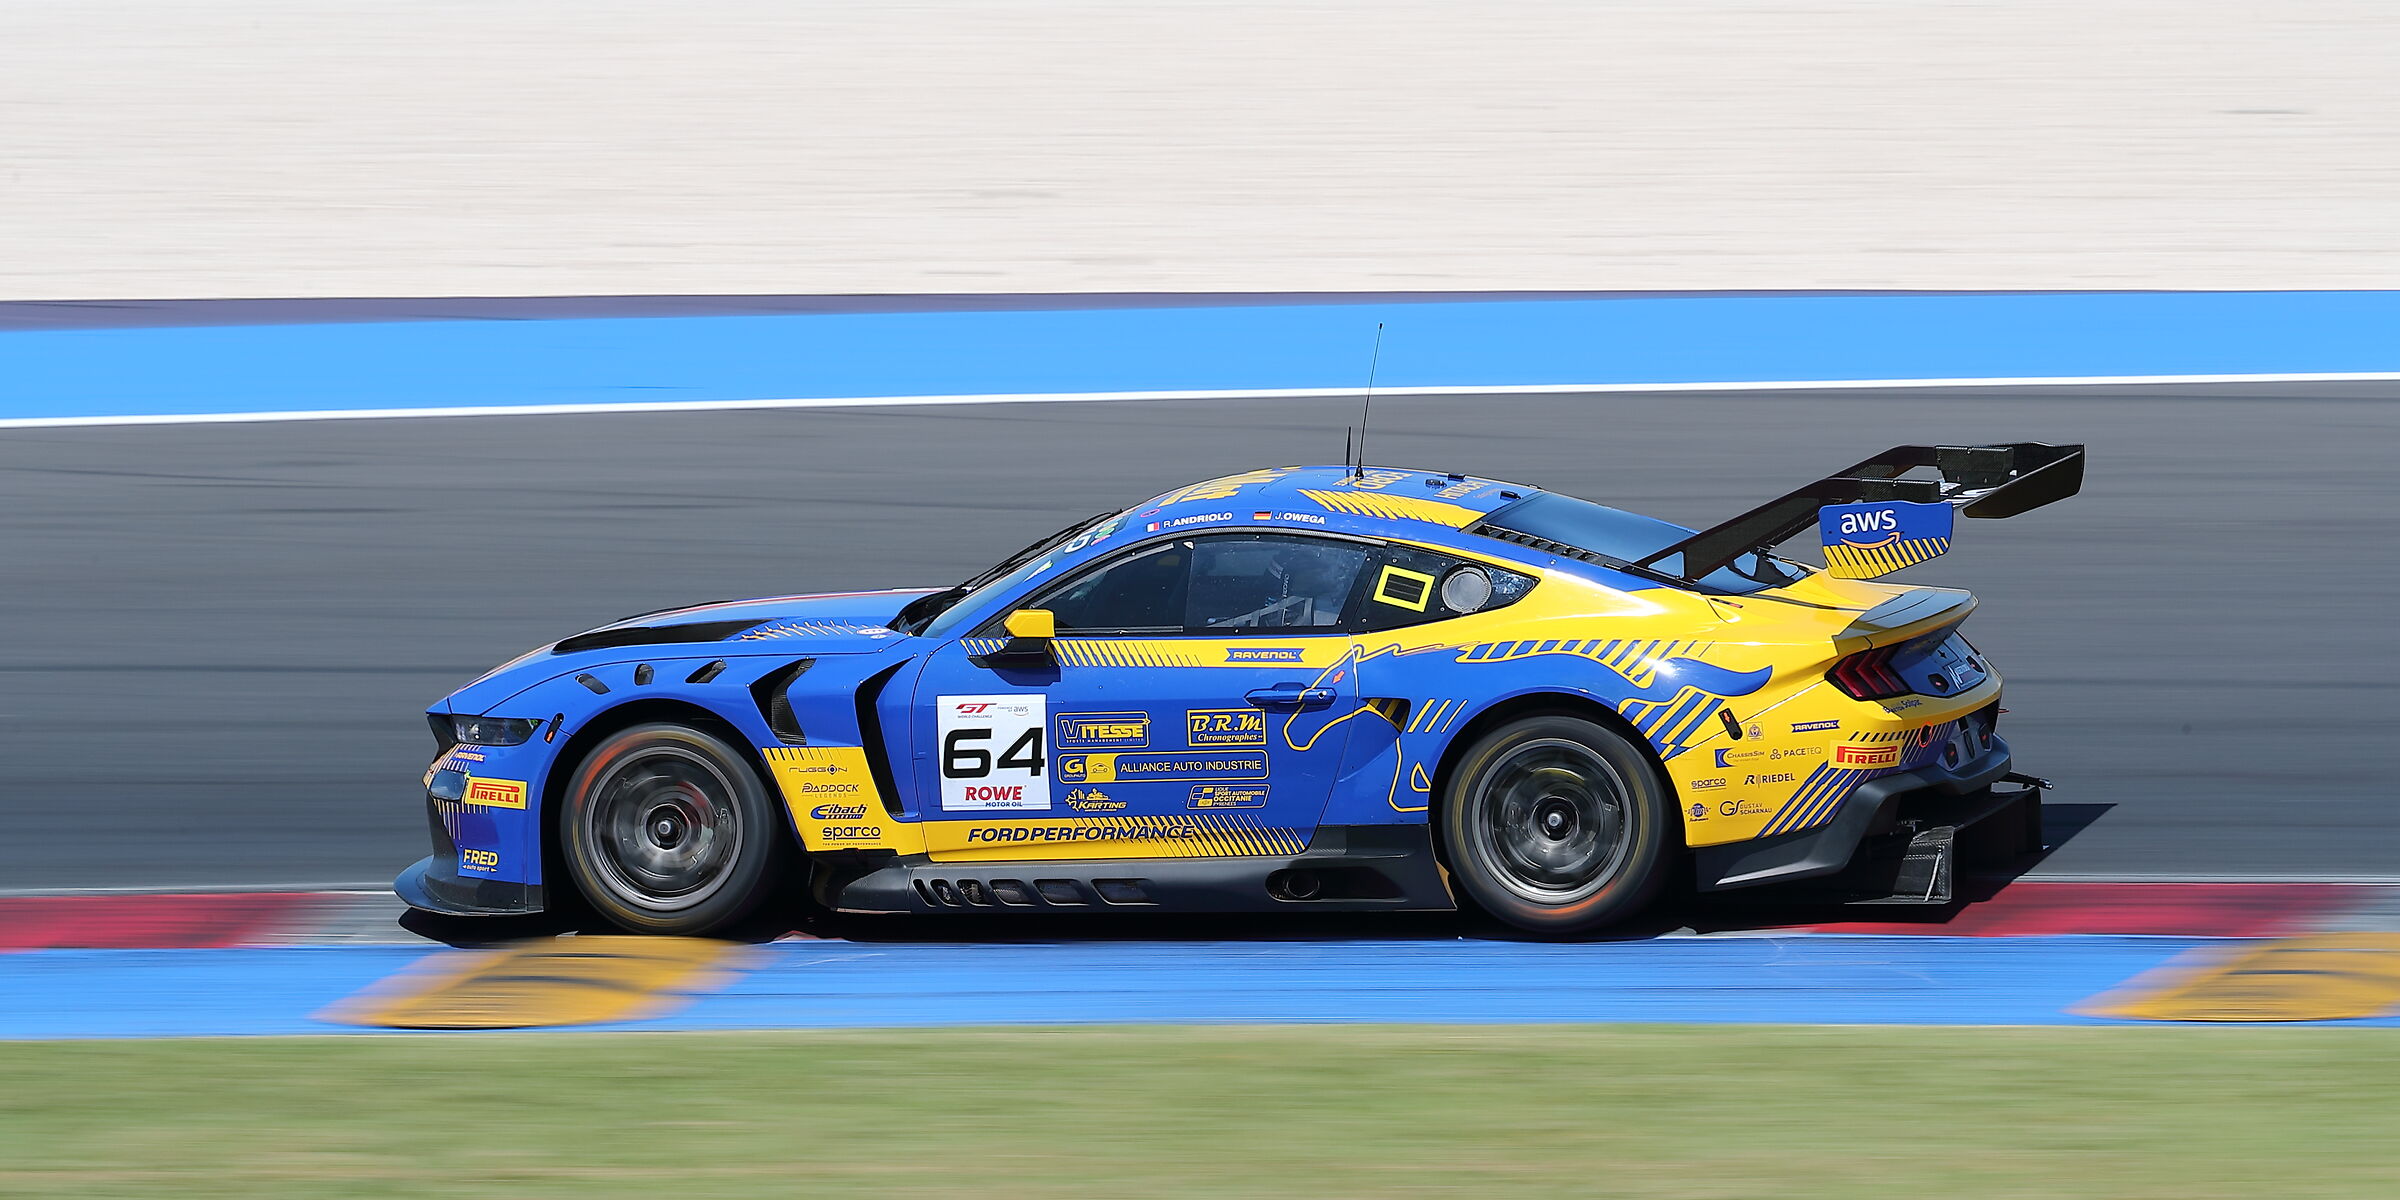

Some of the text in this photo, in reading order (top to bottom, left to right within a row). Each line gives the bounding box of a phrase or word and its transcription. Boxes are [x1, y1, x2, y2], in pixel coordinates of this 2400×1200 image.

[1163, 512, 1233, 529] R.ANDRIOLO
[1274, 511, 1325, 525] J.OWEGA
[1840, 508, 1897, 534] aws
[1233, 651, 1297, 659] RAVENOL
[1060, 719, 1144, 739] VITESSE
[1190, 714, 1262, 732] B.R.M
[1794, 721, 1838, 731] RAVENOL
[1197, 732, 1258, 742] Chronographes
[943, 727, 1045, 779] 64
[1783, 746, 1822, 757] PACETEQ
[1836, 745, 1898, 764] PIRELLI
[1120, 760, 1262, 773] ALLIANCE AUTO INDUSTRIE
[1691, 778, 1727, 789] sparco
[1762, 773, 1796, 784] RIEDEL
[470, 782, 520, 804] PIRELLI
[802, 782, 859, 793] PADDOCK
[965, 786, 1023, 801] ROWE
[810, 804, 867, 819] Eibach
[822, 826, 881, 840] sparco
[463, 849, 499, 866] FRED
